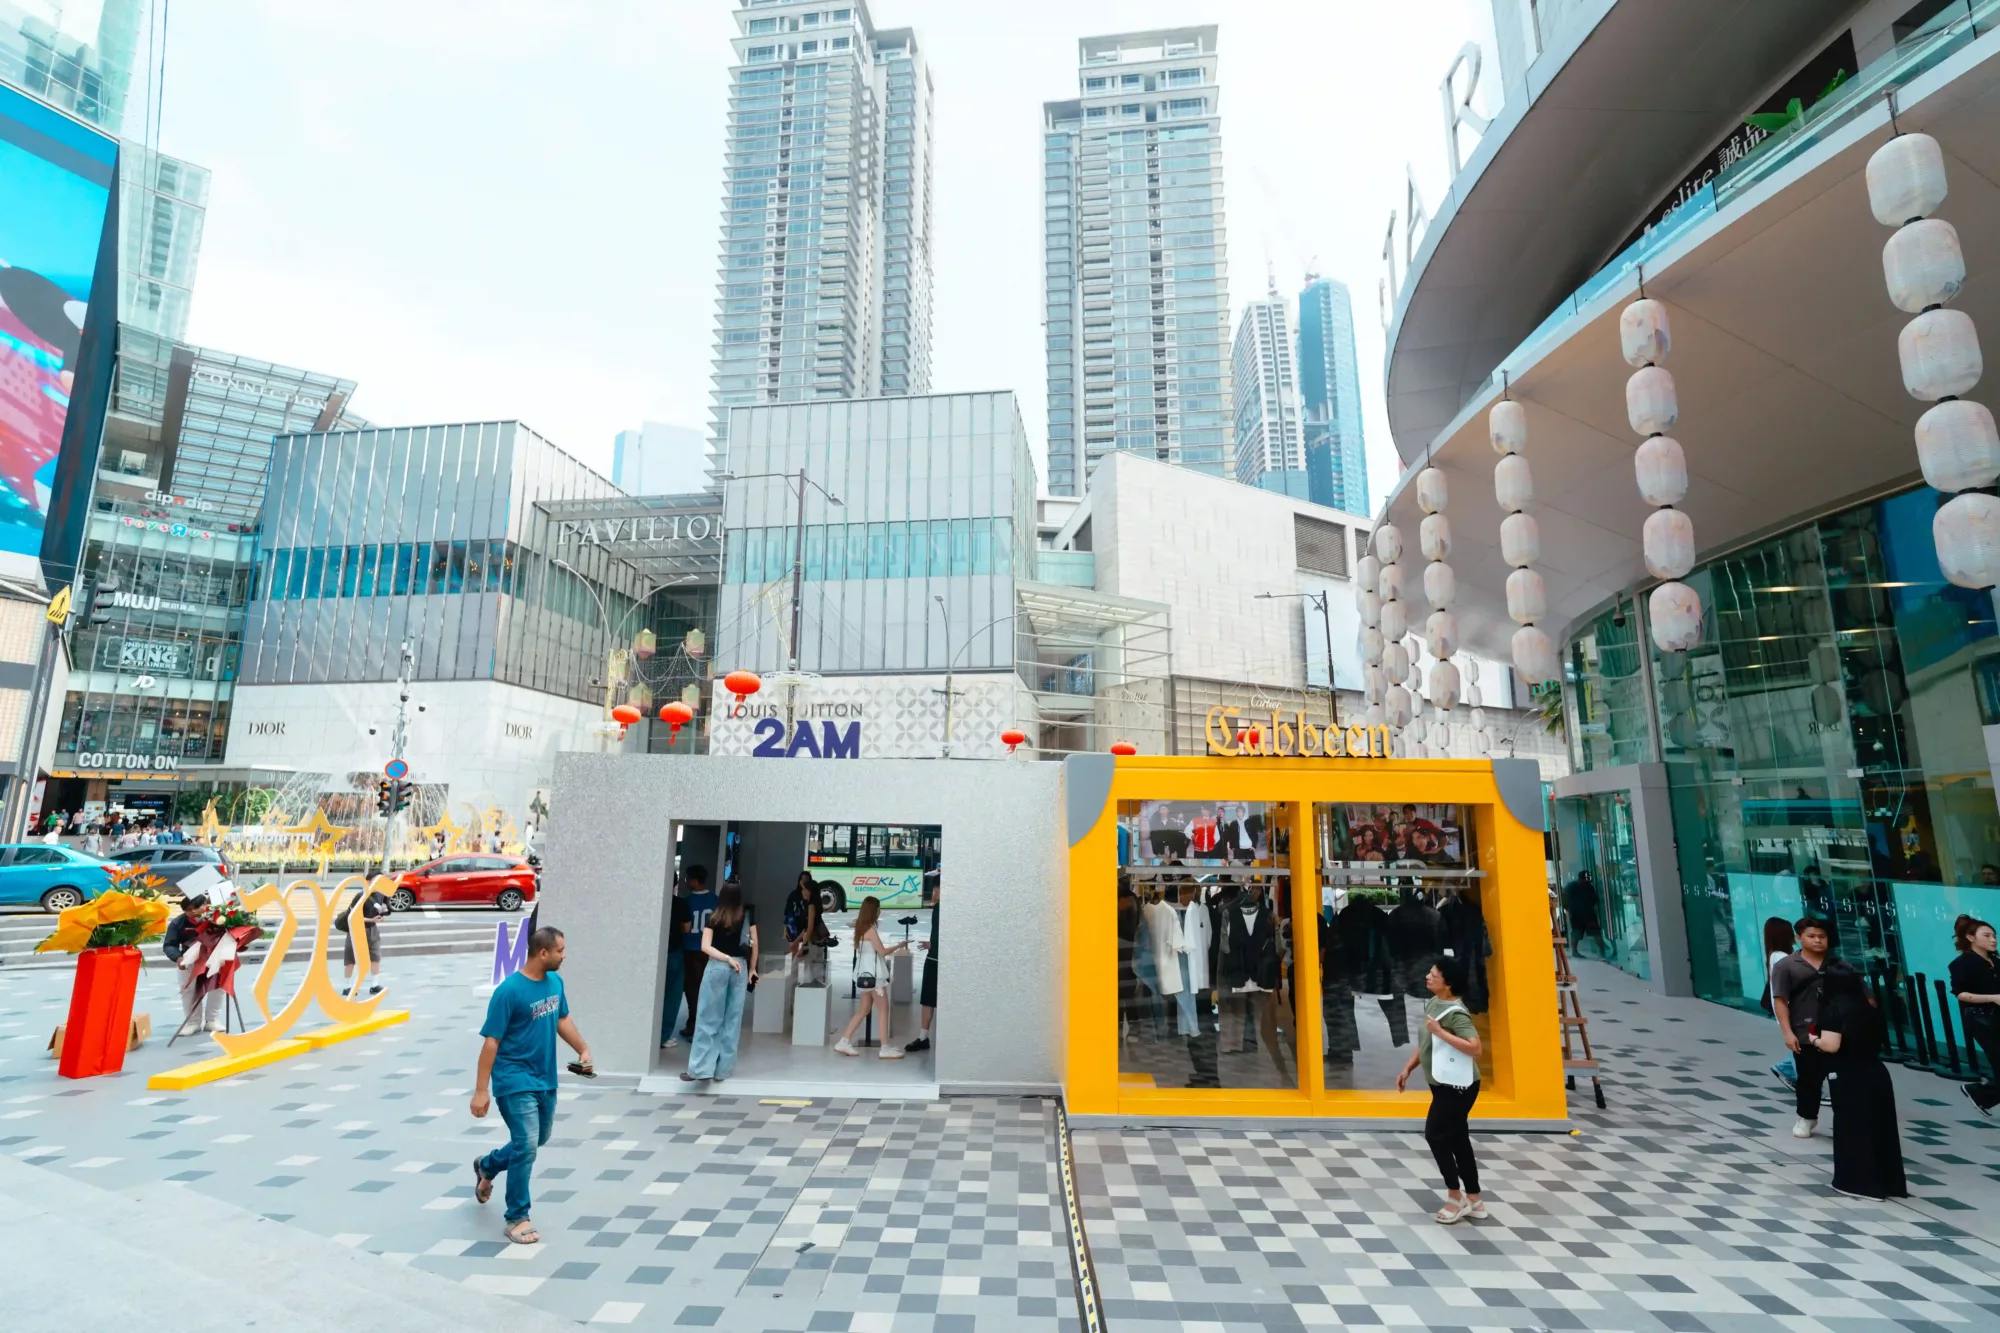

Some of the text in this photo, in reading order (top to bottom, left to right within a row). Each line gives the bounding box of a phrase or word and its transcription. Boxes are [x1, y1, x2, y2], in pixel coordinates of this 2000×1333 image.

[194, 369, 329, 412] CONNECTION
[113, 591, 161, 611] MUJI
[121, 647, 178, 664] KING
[129, 674, 156, 689] JD
[726, 702, 863, 719] LOUIS UITTON
[1250, 694, 1282, 710] Cartier
[248, 721, 286, 736] DIOR
[504, 722, 533, 739] DIOR
[1204, 706, 1394, 759] Cabbeen
[752, 717, 861, 759] 2AM
[78, 751, 179, 771] COTTON ON
[852, 876, 900, 886] GOKL
